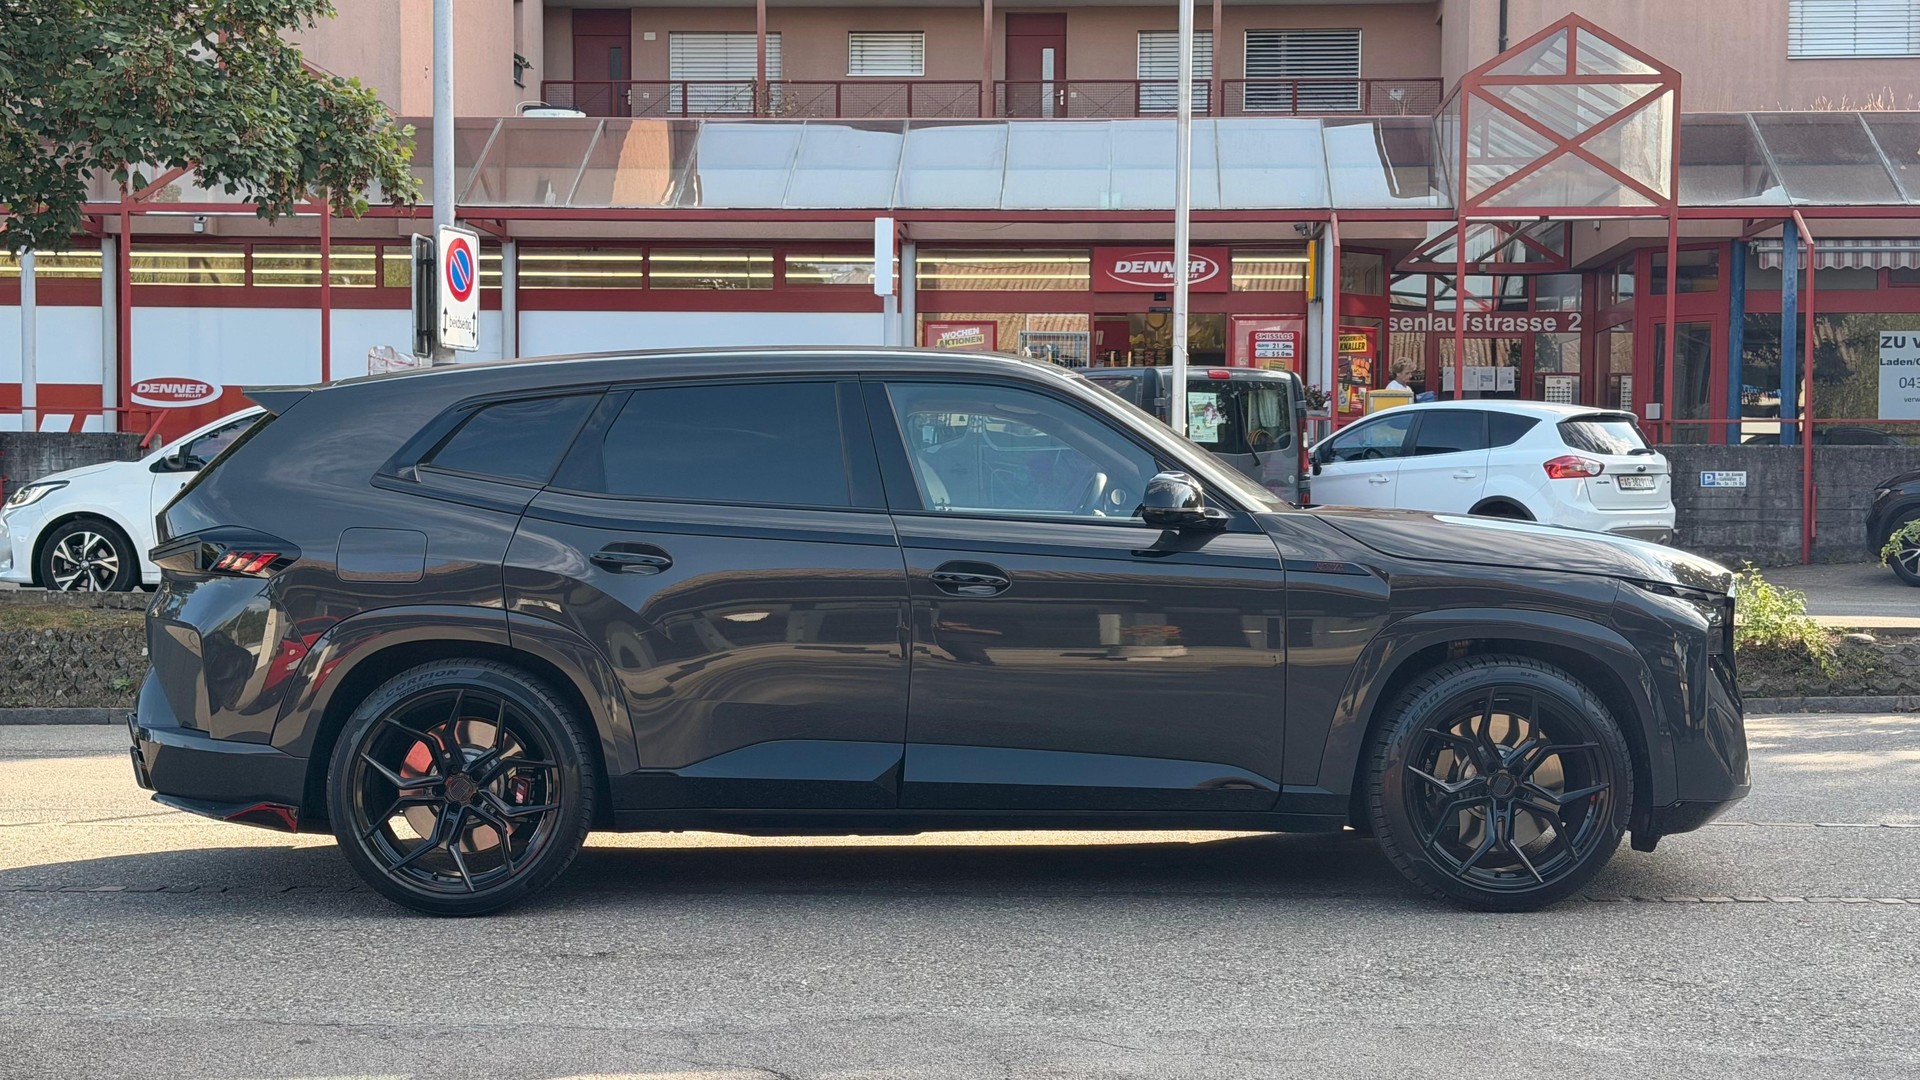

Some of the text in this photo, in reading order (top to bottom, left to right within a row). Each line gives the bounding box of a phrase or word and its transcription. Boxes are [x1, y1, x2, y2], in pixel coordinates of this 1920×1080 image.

[1114, 261, 1207, 273] DENNR
[1568, 313, 1582, 332] 2
[941, 327, 980, 340] WOCHEN
[939, 336, 983, 347] AKTIONEN
[1880, 336, 1906, 349] ZU
[136, 383, 208, 394] DENNER
